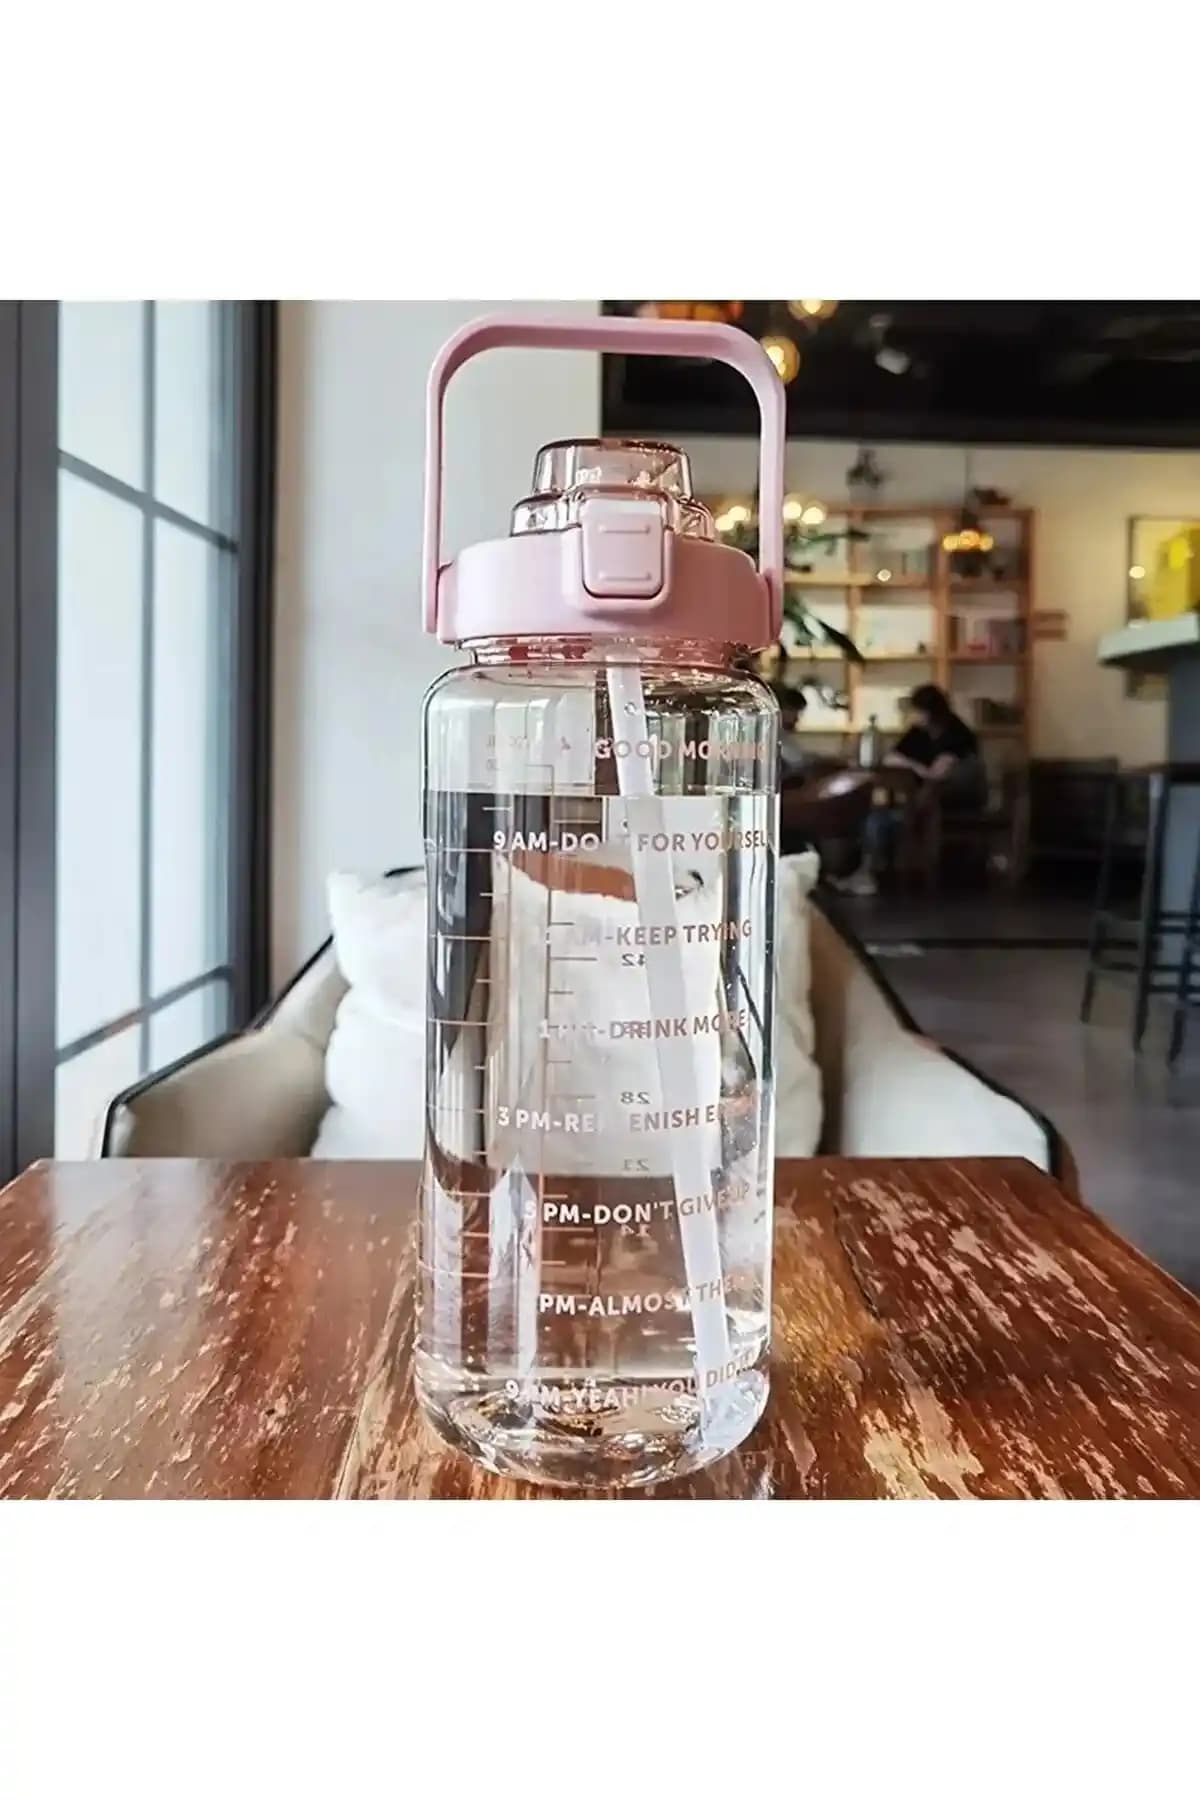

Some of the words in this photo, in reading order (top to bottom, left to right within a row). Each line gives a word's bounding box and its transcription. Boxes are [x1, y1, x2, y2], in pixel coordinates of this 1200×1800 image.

[594, 738, 673, 759] GOOD
[493, 830, 505, 850] 9
[637, 832, 685, 851] FOR
[682, 920, 752, 943] TRYING
[498, 1105, 510, 1127] 3
[542, 1200, 674, 1225] PM-DON'T
[680, 1189, 728, 1216] GIVE
[706, 1361, 736, 1389] DID
